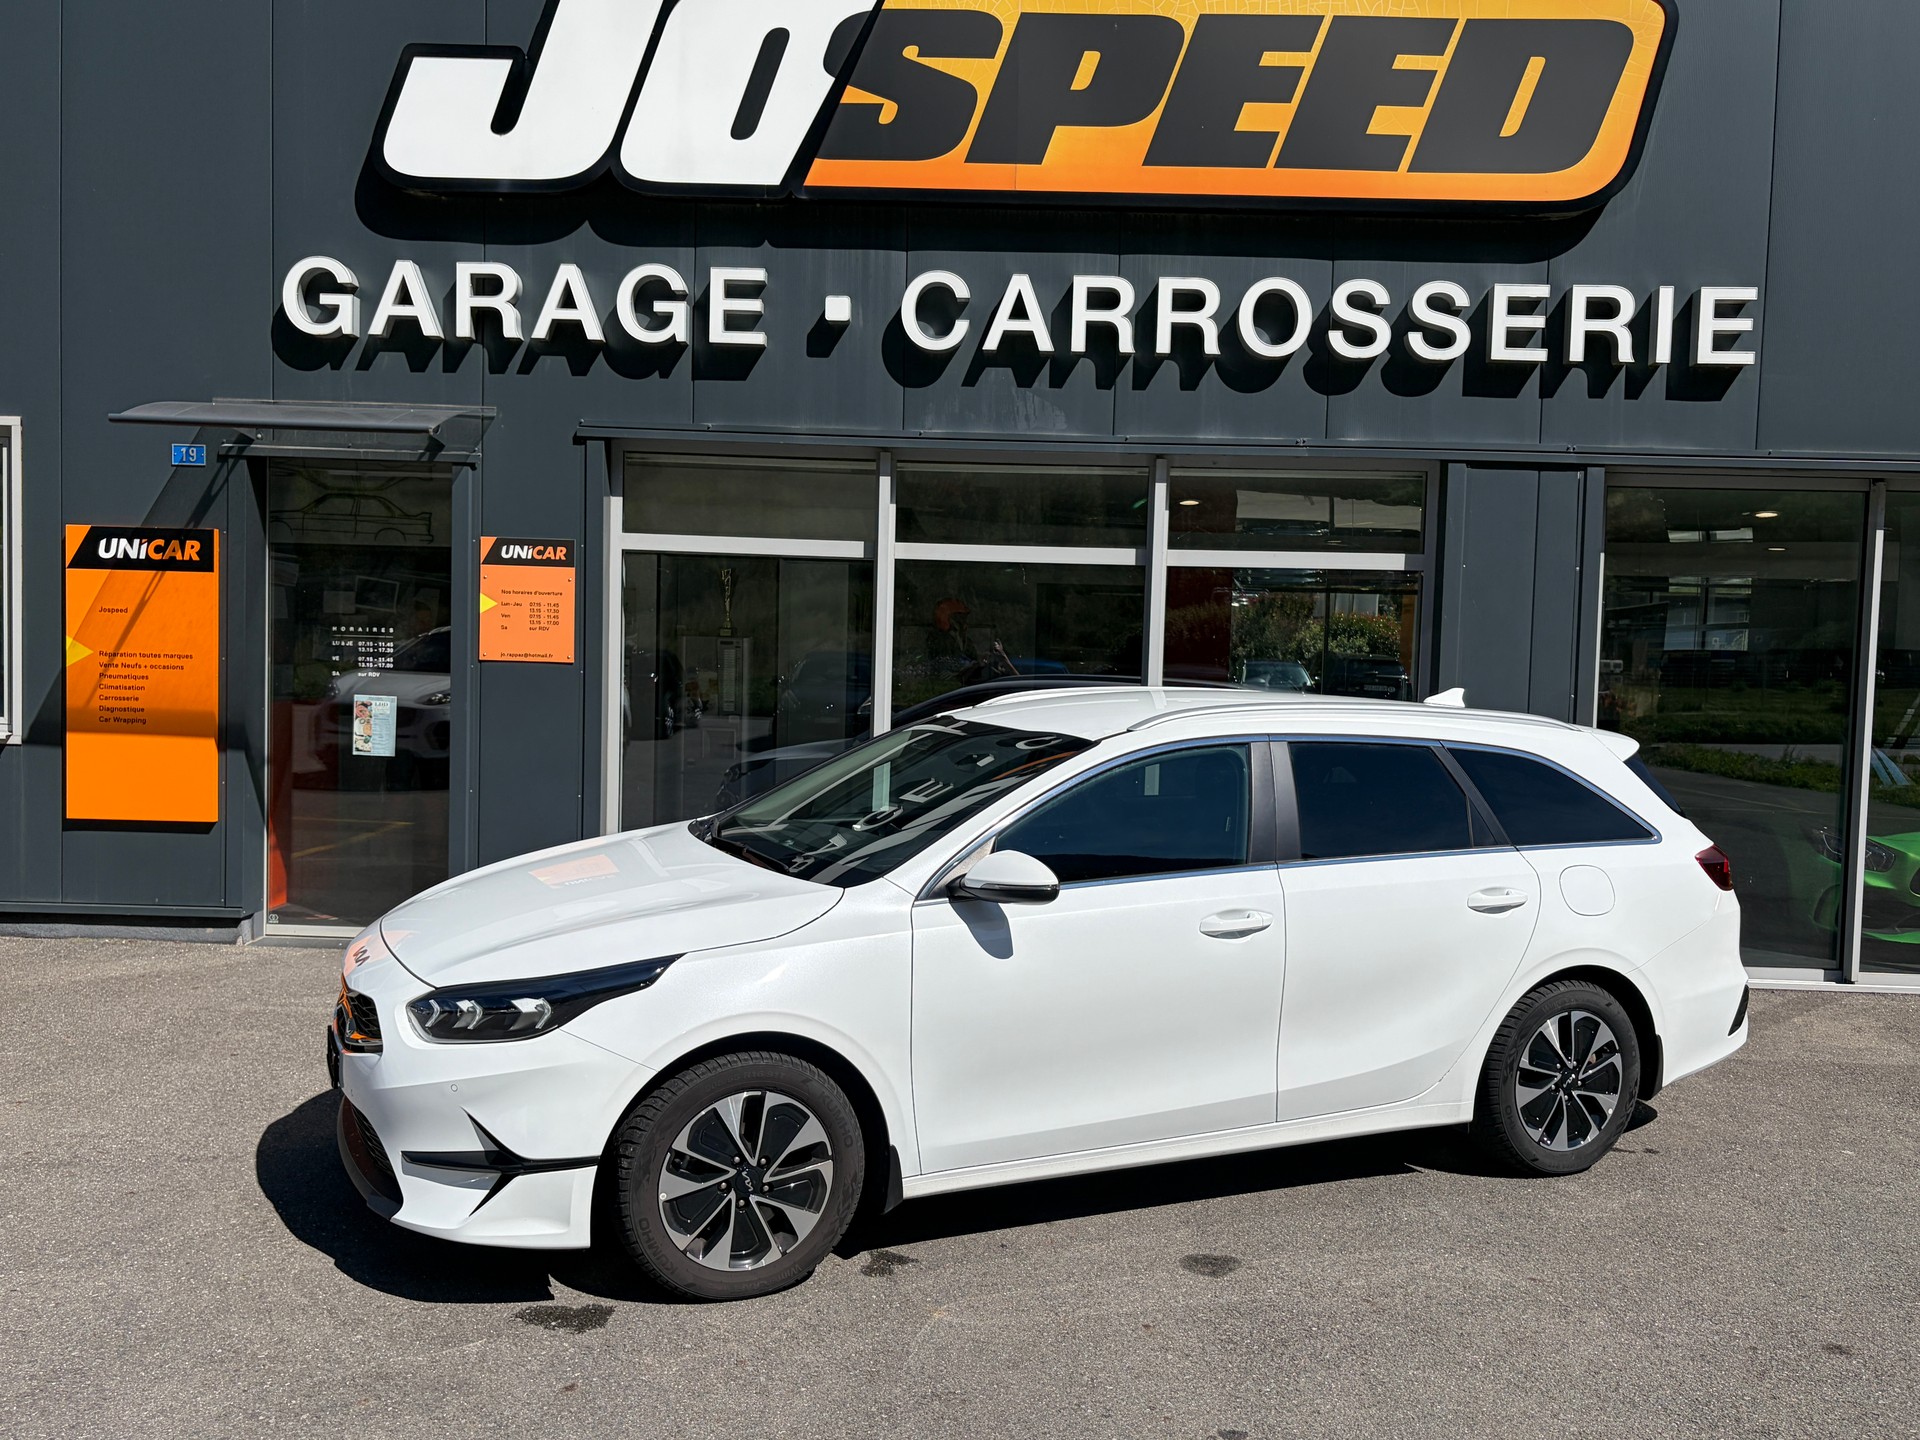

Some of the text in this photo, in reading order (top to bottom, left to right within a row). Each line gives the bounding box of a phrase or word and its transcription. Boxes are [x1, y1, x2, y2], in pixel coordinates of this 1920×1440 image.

[282, 255, 768, 348] GARAGE
[900, 269, 1759, 367] CARROSSERIE
[180, 447, 197, 462] 19
[98, 606, 128, 614] Jospeed
[98, 650, 137, 659] Réparation
[98, 672, 149, 681] Pneumatiques
[98, 683, 145, 691] Climatisation
[98, 694, 140, 702] Carrosserie
[98, 705, 145, 713] Diagnostique
[113, 716, 147, 725] Wrapping
